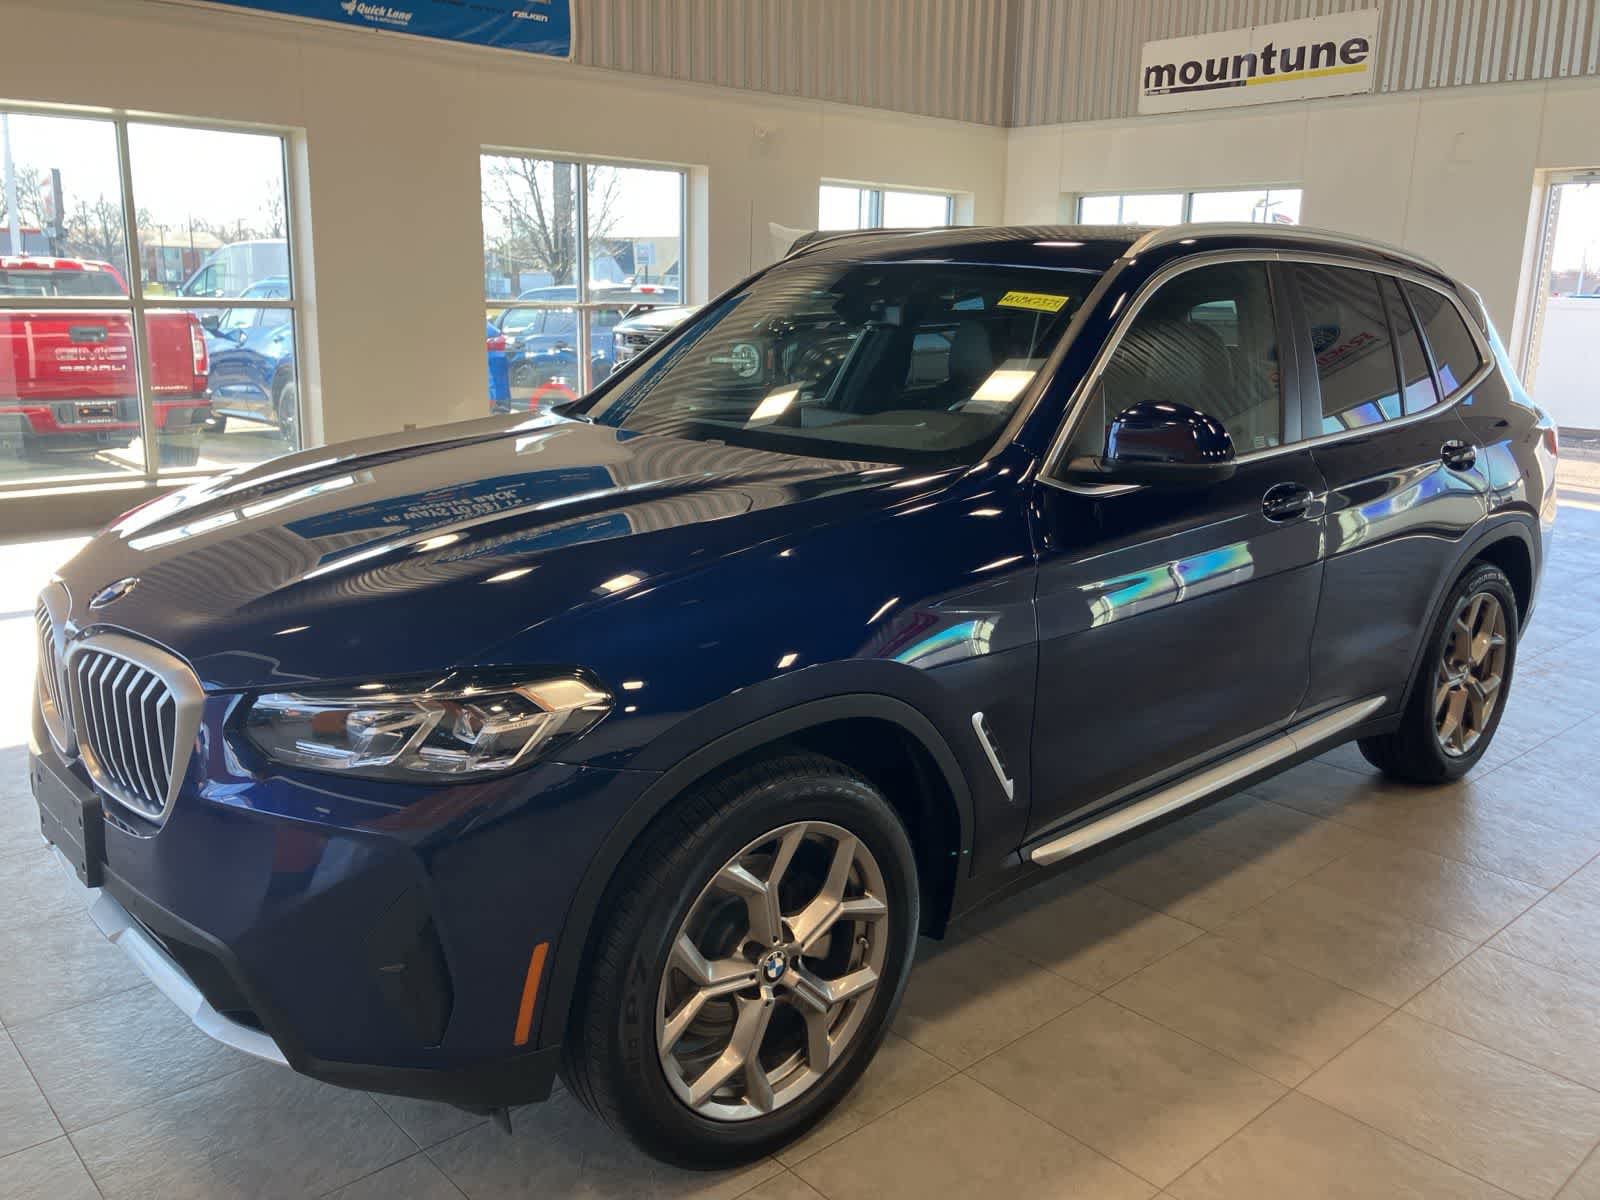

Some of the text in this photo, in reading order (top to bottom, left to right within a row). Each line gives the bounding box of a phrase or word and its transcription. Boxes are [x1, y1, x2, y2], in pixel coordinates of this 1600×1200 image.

[357, 2, 386, 17] Quick
[386, 7, 413, 22] Lane
[512, 9, 549, 23] FALKEN
[1143, 36, 1370, 89] mountune
